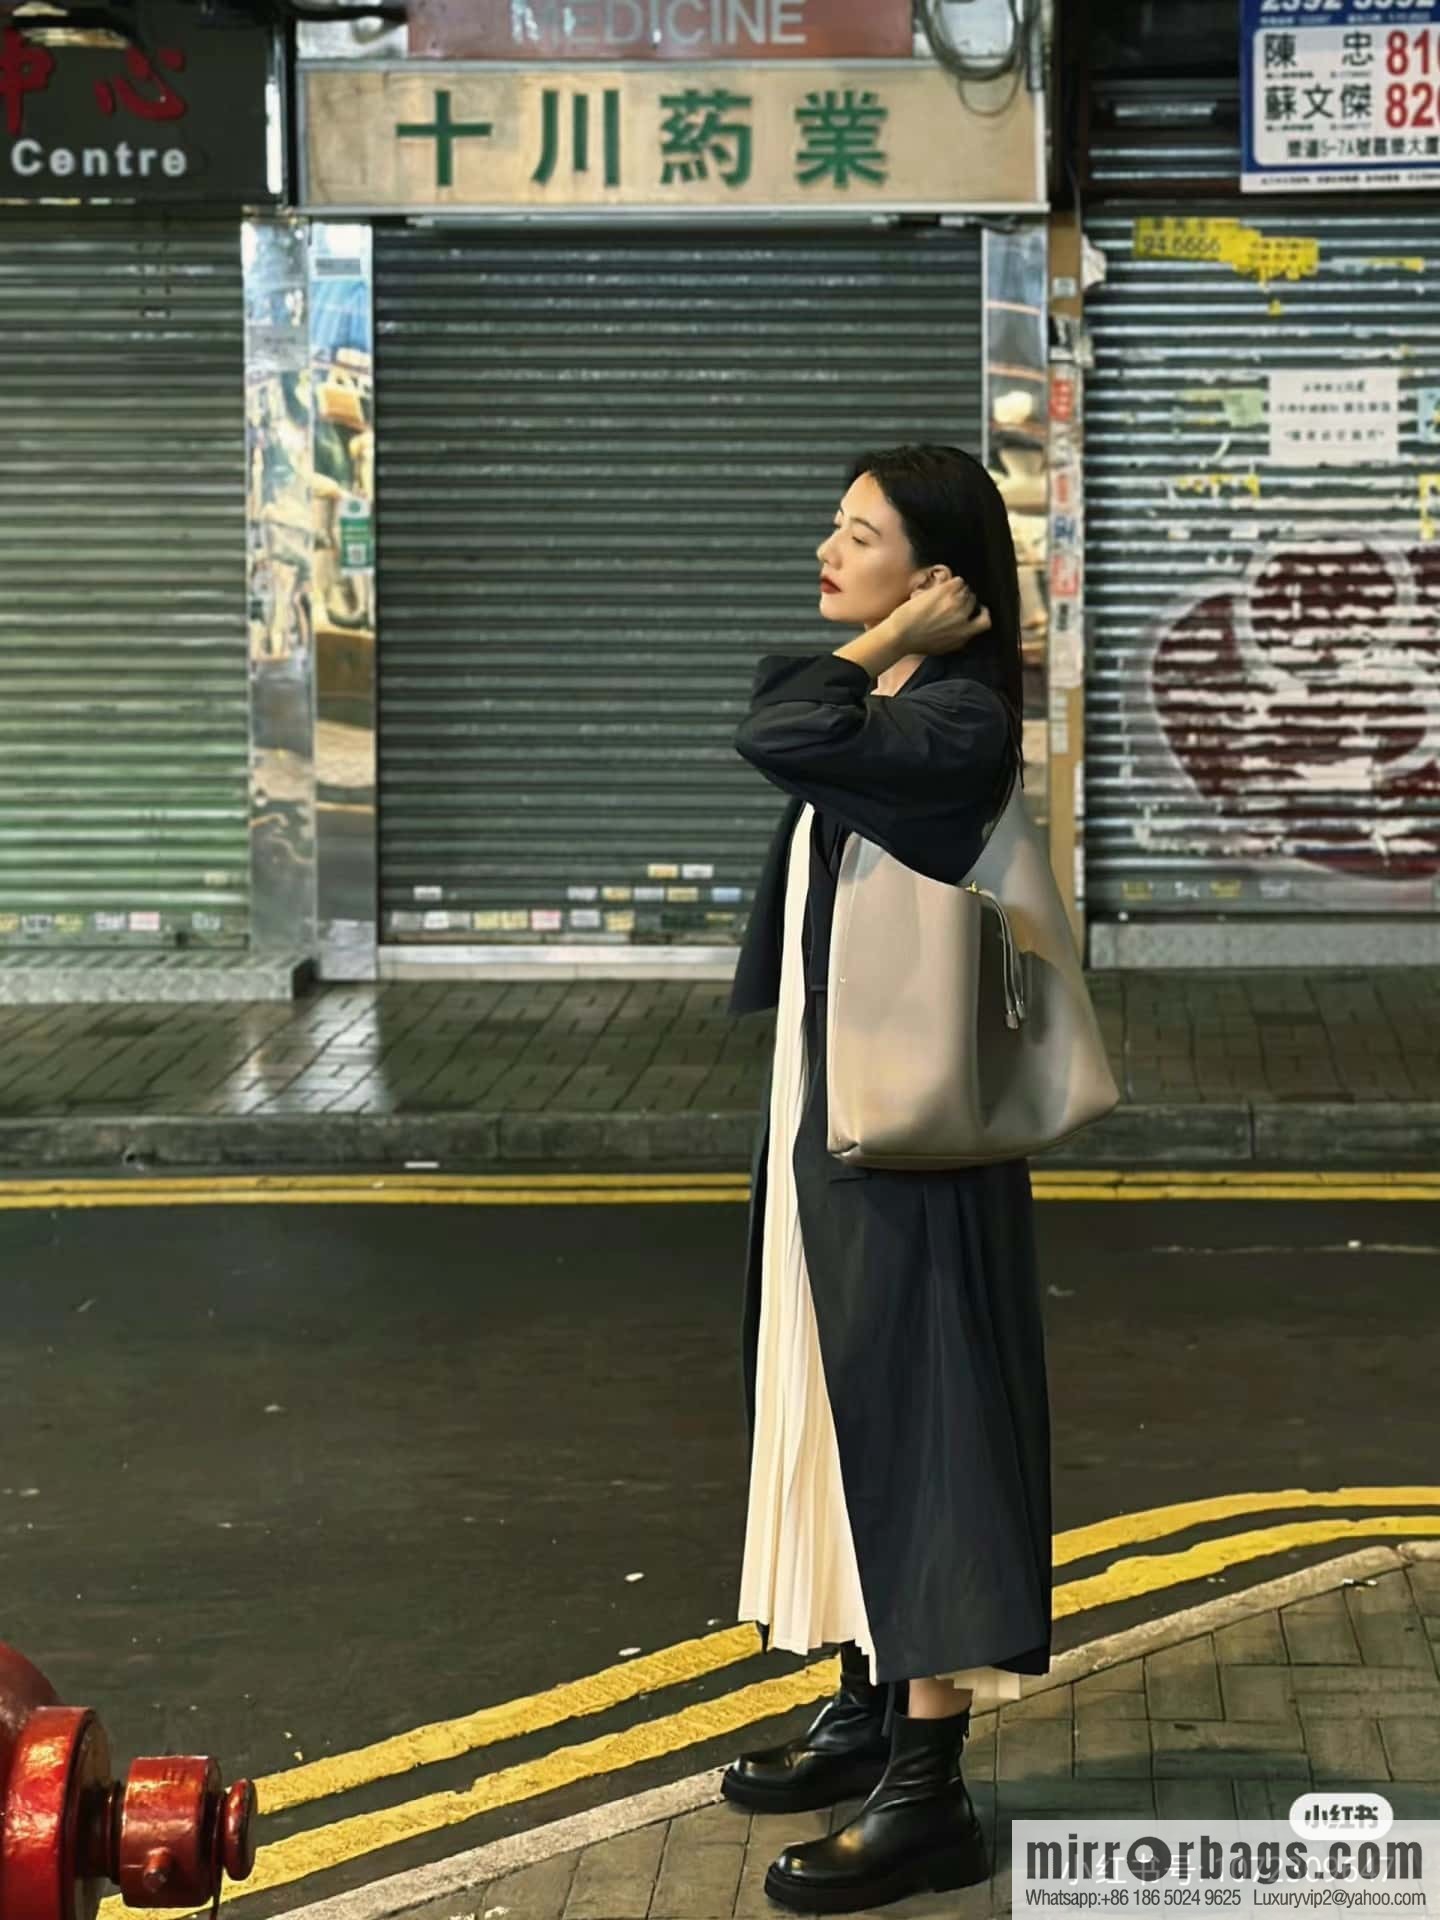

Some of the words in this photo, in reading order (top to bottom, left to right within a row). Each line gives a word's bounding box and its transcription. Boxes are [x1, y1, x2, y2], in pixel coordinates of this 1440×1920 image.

[510, 0, 807, 44] MEDICINE
[1386, 30, 1440, 75] 81
[0, 27, 186, 136] 中心
[1386, 83, 1440, 128] 82
[11, 139, 187, 176] Centre
